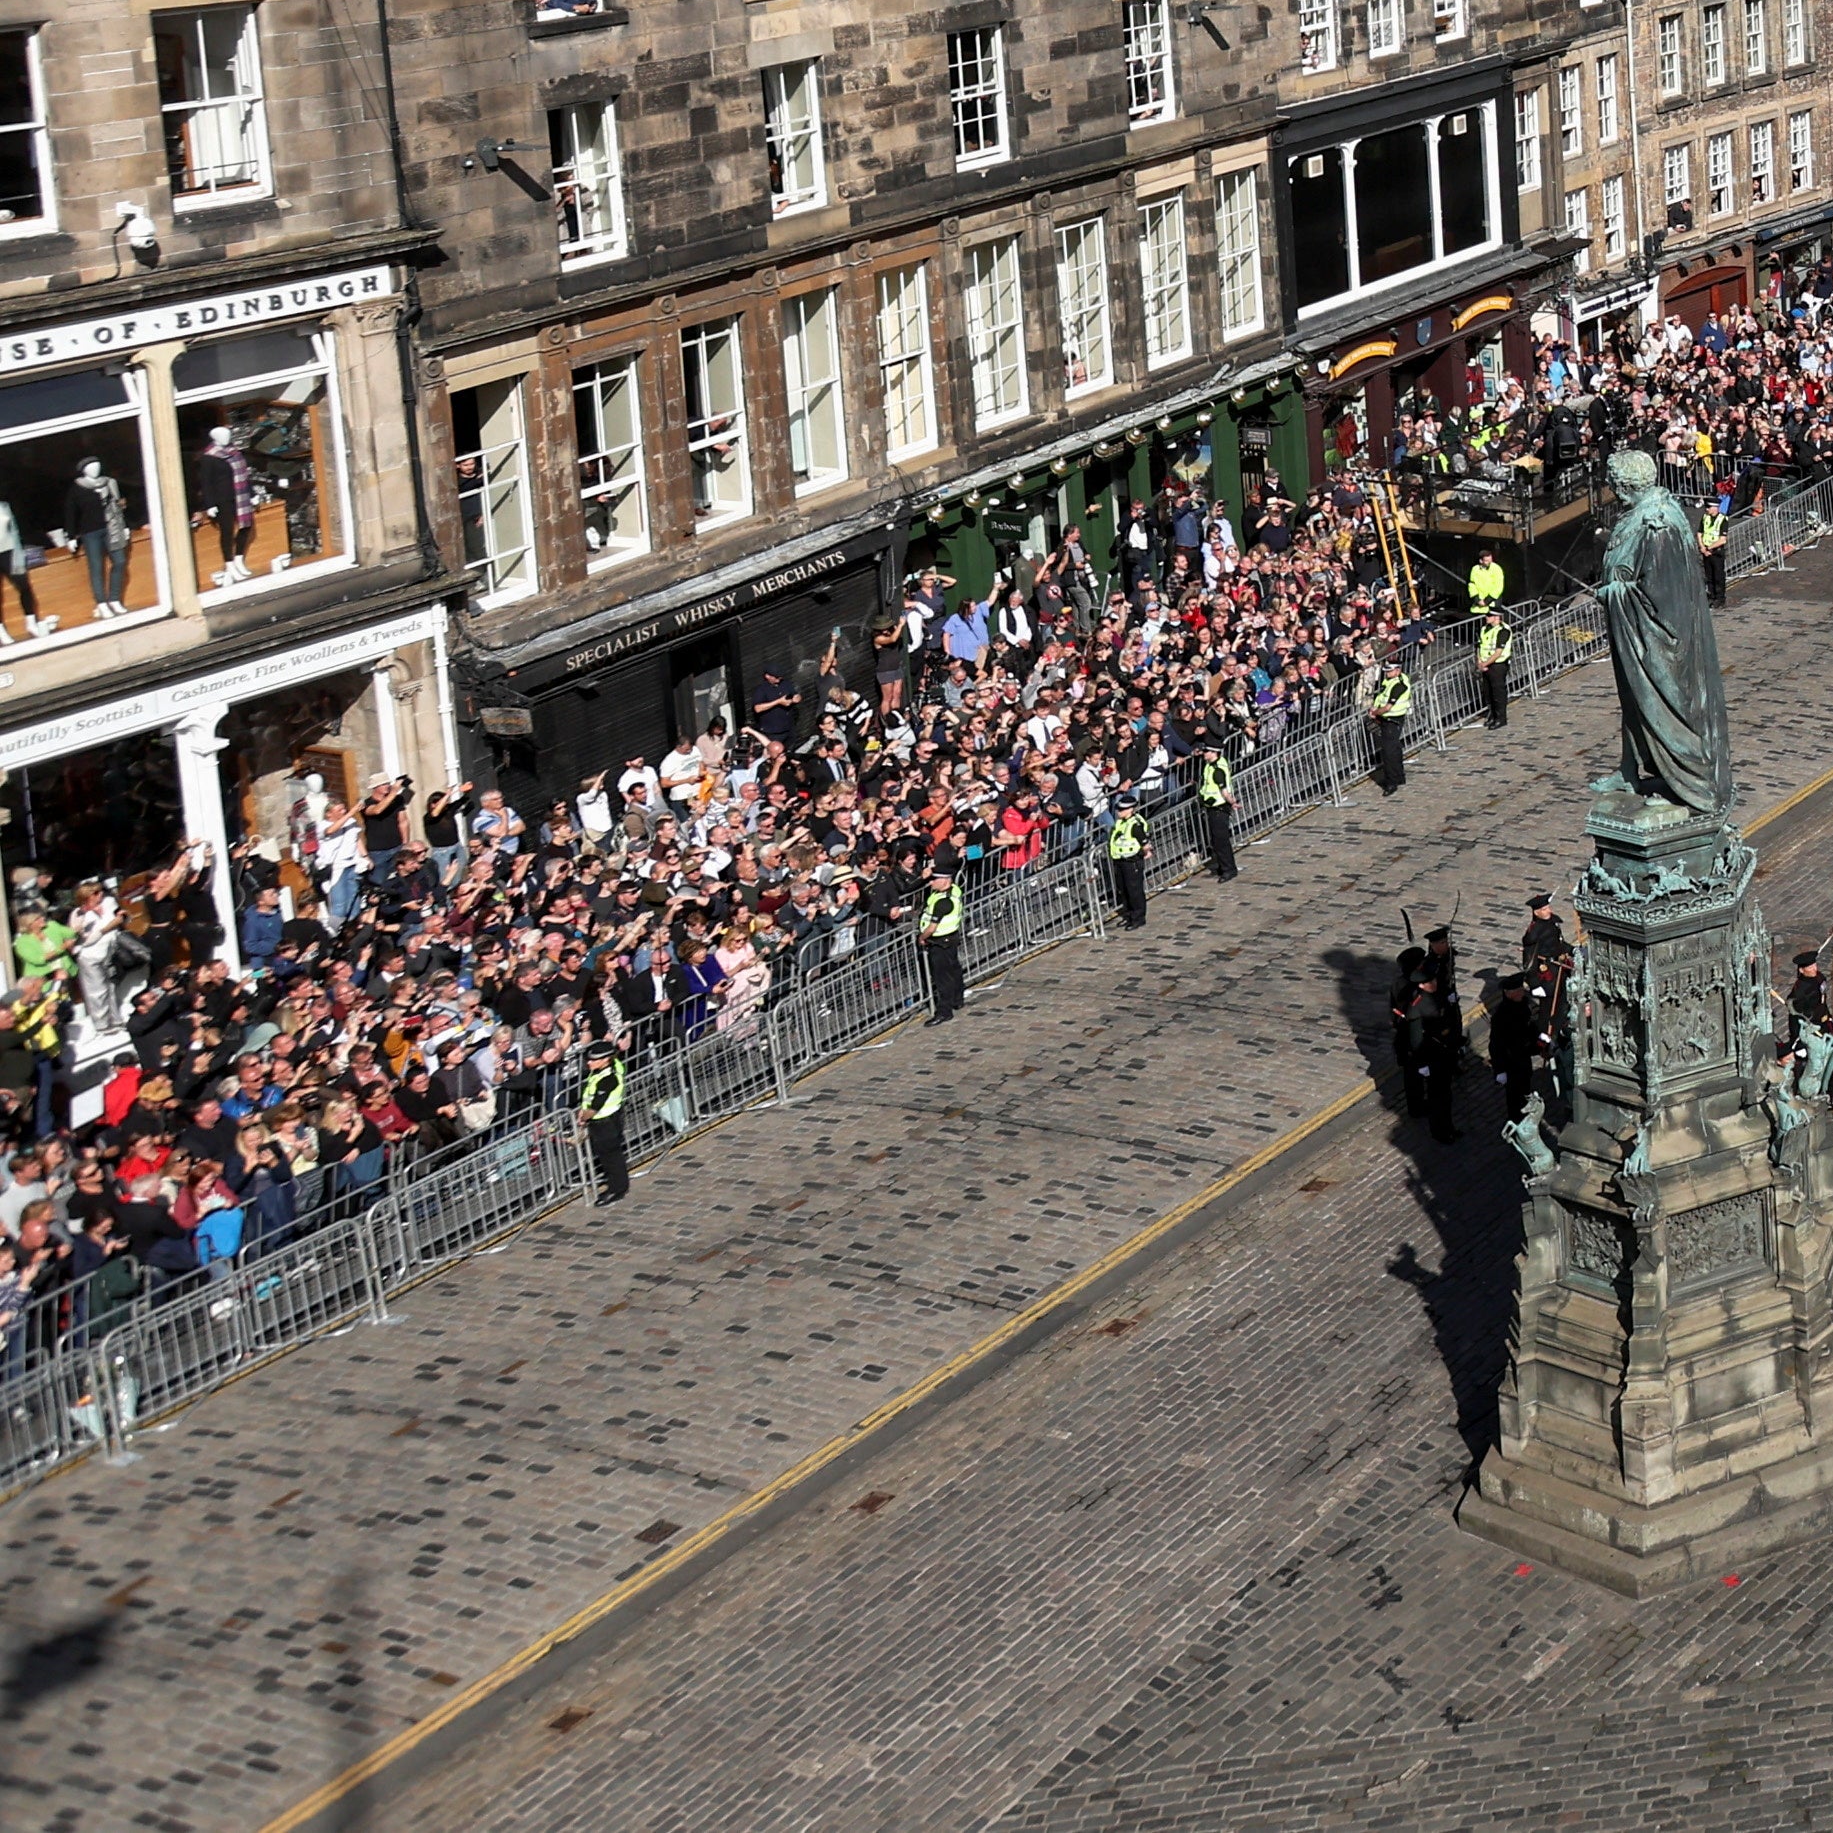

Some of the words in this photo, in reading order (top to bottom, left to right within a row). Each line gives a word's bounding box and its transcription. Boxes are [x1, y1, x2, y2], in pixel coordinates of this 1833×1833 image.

[93, 321, 137, 345] OF
[175, 275, 380, 329] EDINBURGH
[566, 622, 660, 671] SPECIALIST
[674, 592, 737, 627] WHISKY
[751, 551, 846, 597] MERCHANTS
[254, 660, 287, 679] Fine
[290, 640, 355, 667] Woollens
[358, 634, 368, 647] &
[372, 620, 423, 643] Tweeds
[75, 702, 144, 732] Scottish
